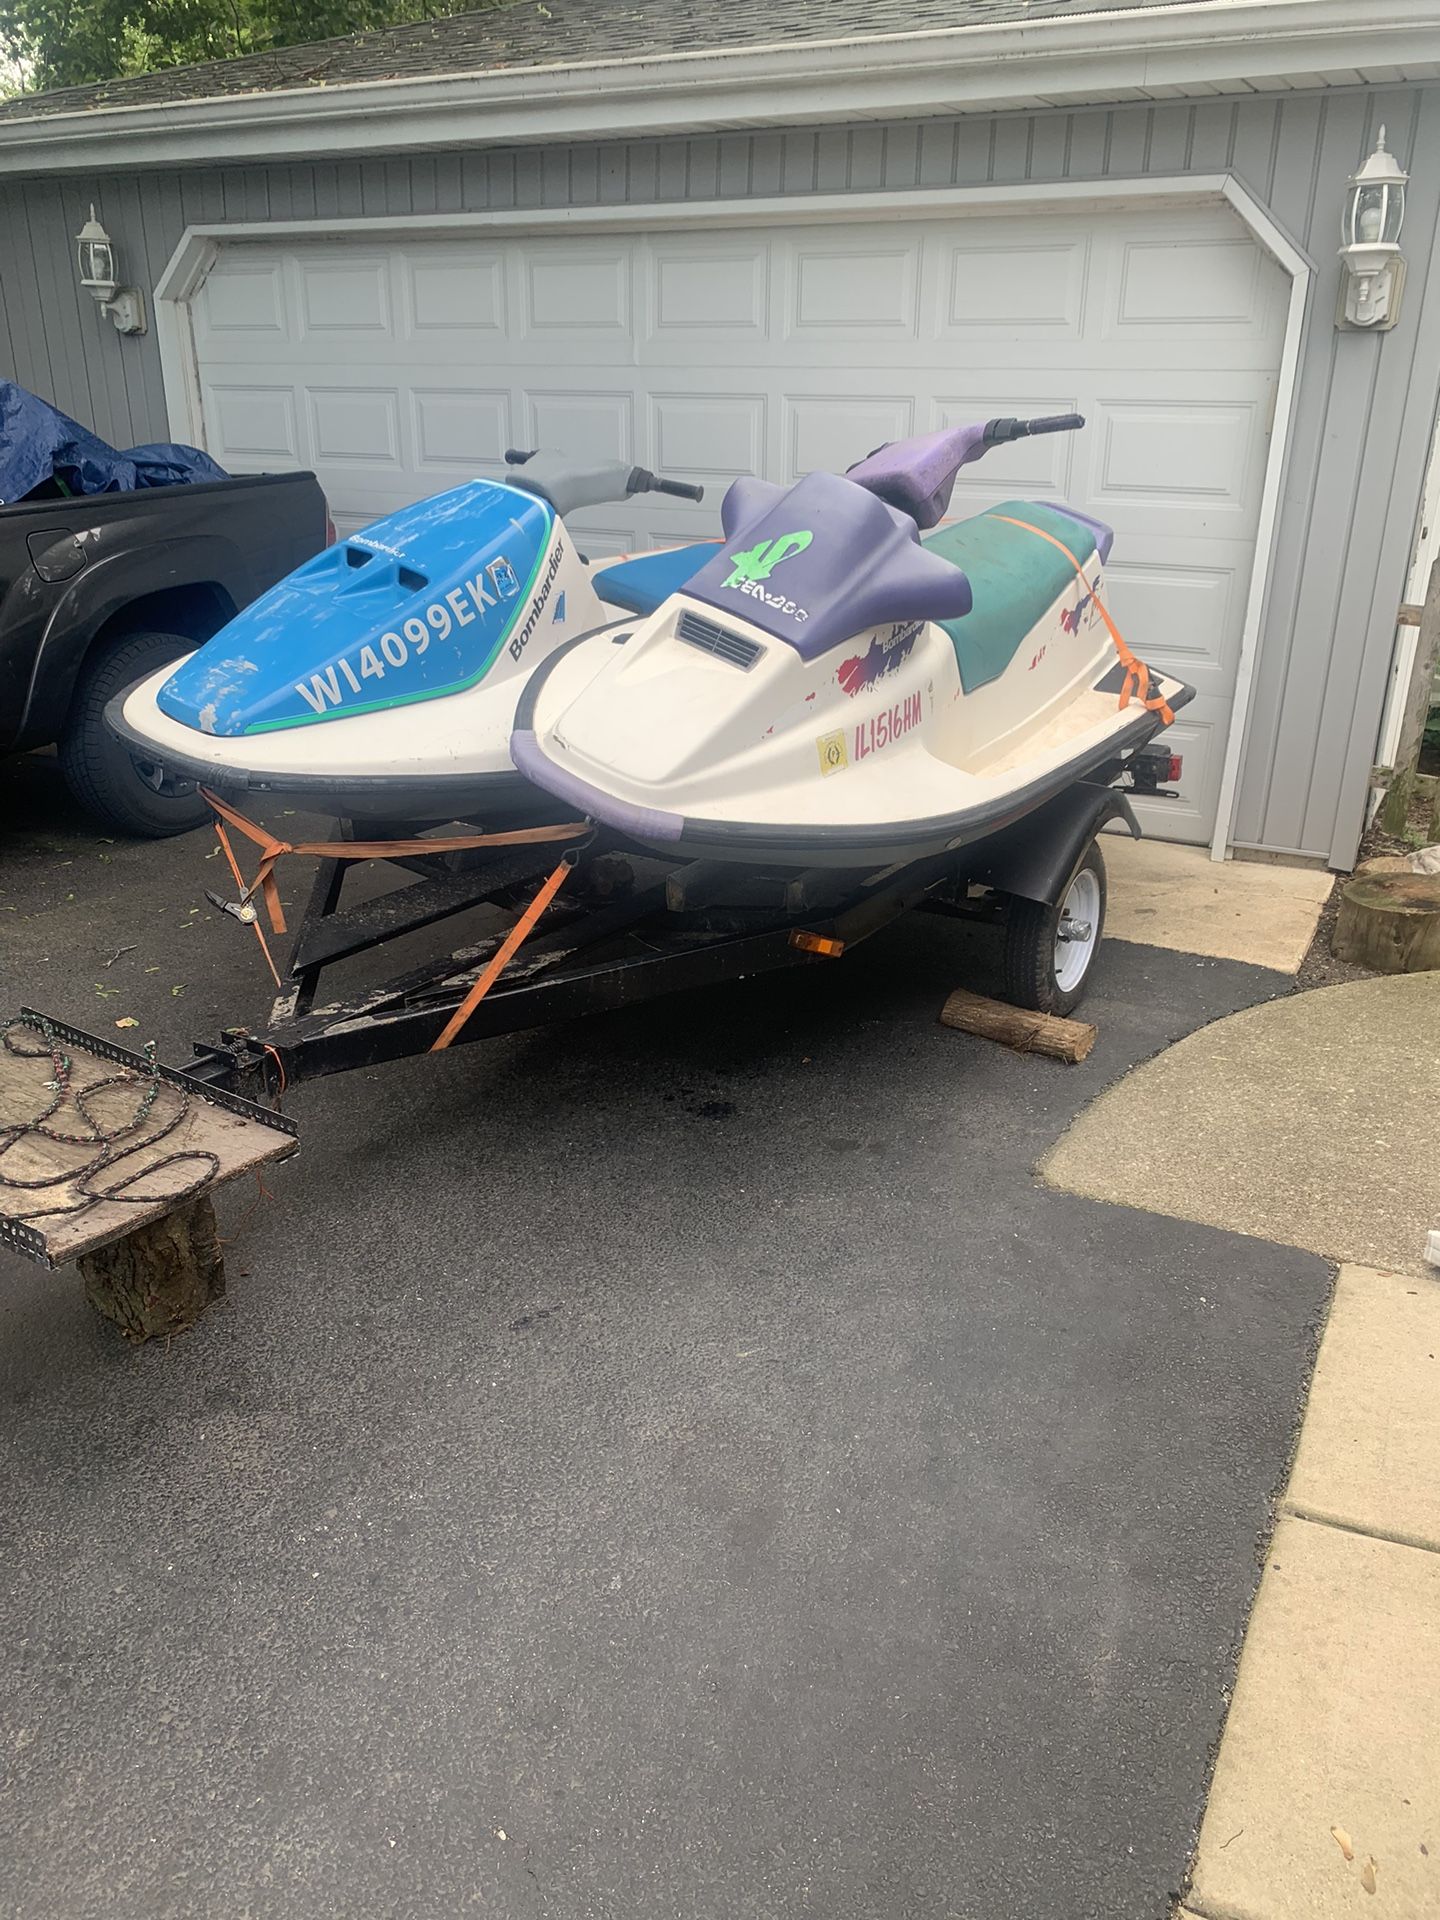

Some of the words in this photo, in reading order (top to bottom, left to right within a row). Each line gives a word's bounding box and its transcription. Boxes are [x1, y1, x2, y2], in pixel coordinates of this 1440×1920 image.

[295, 573, 497, 714] WI4099EK
[509, 538, 564, 662] Bombardier
[855, 690, 922, 761] IL1516HM
